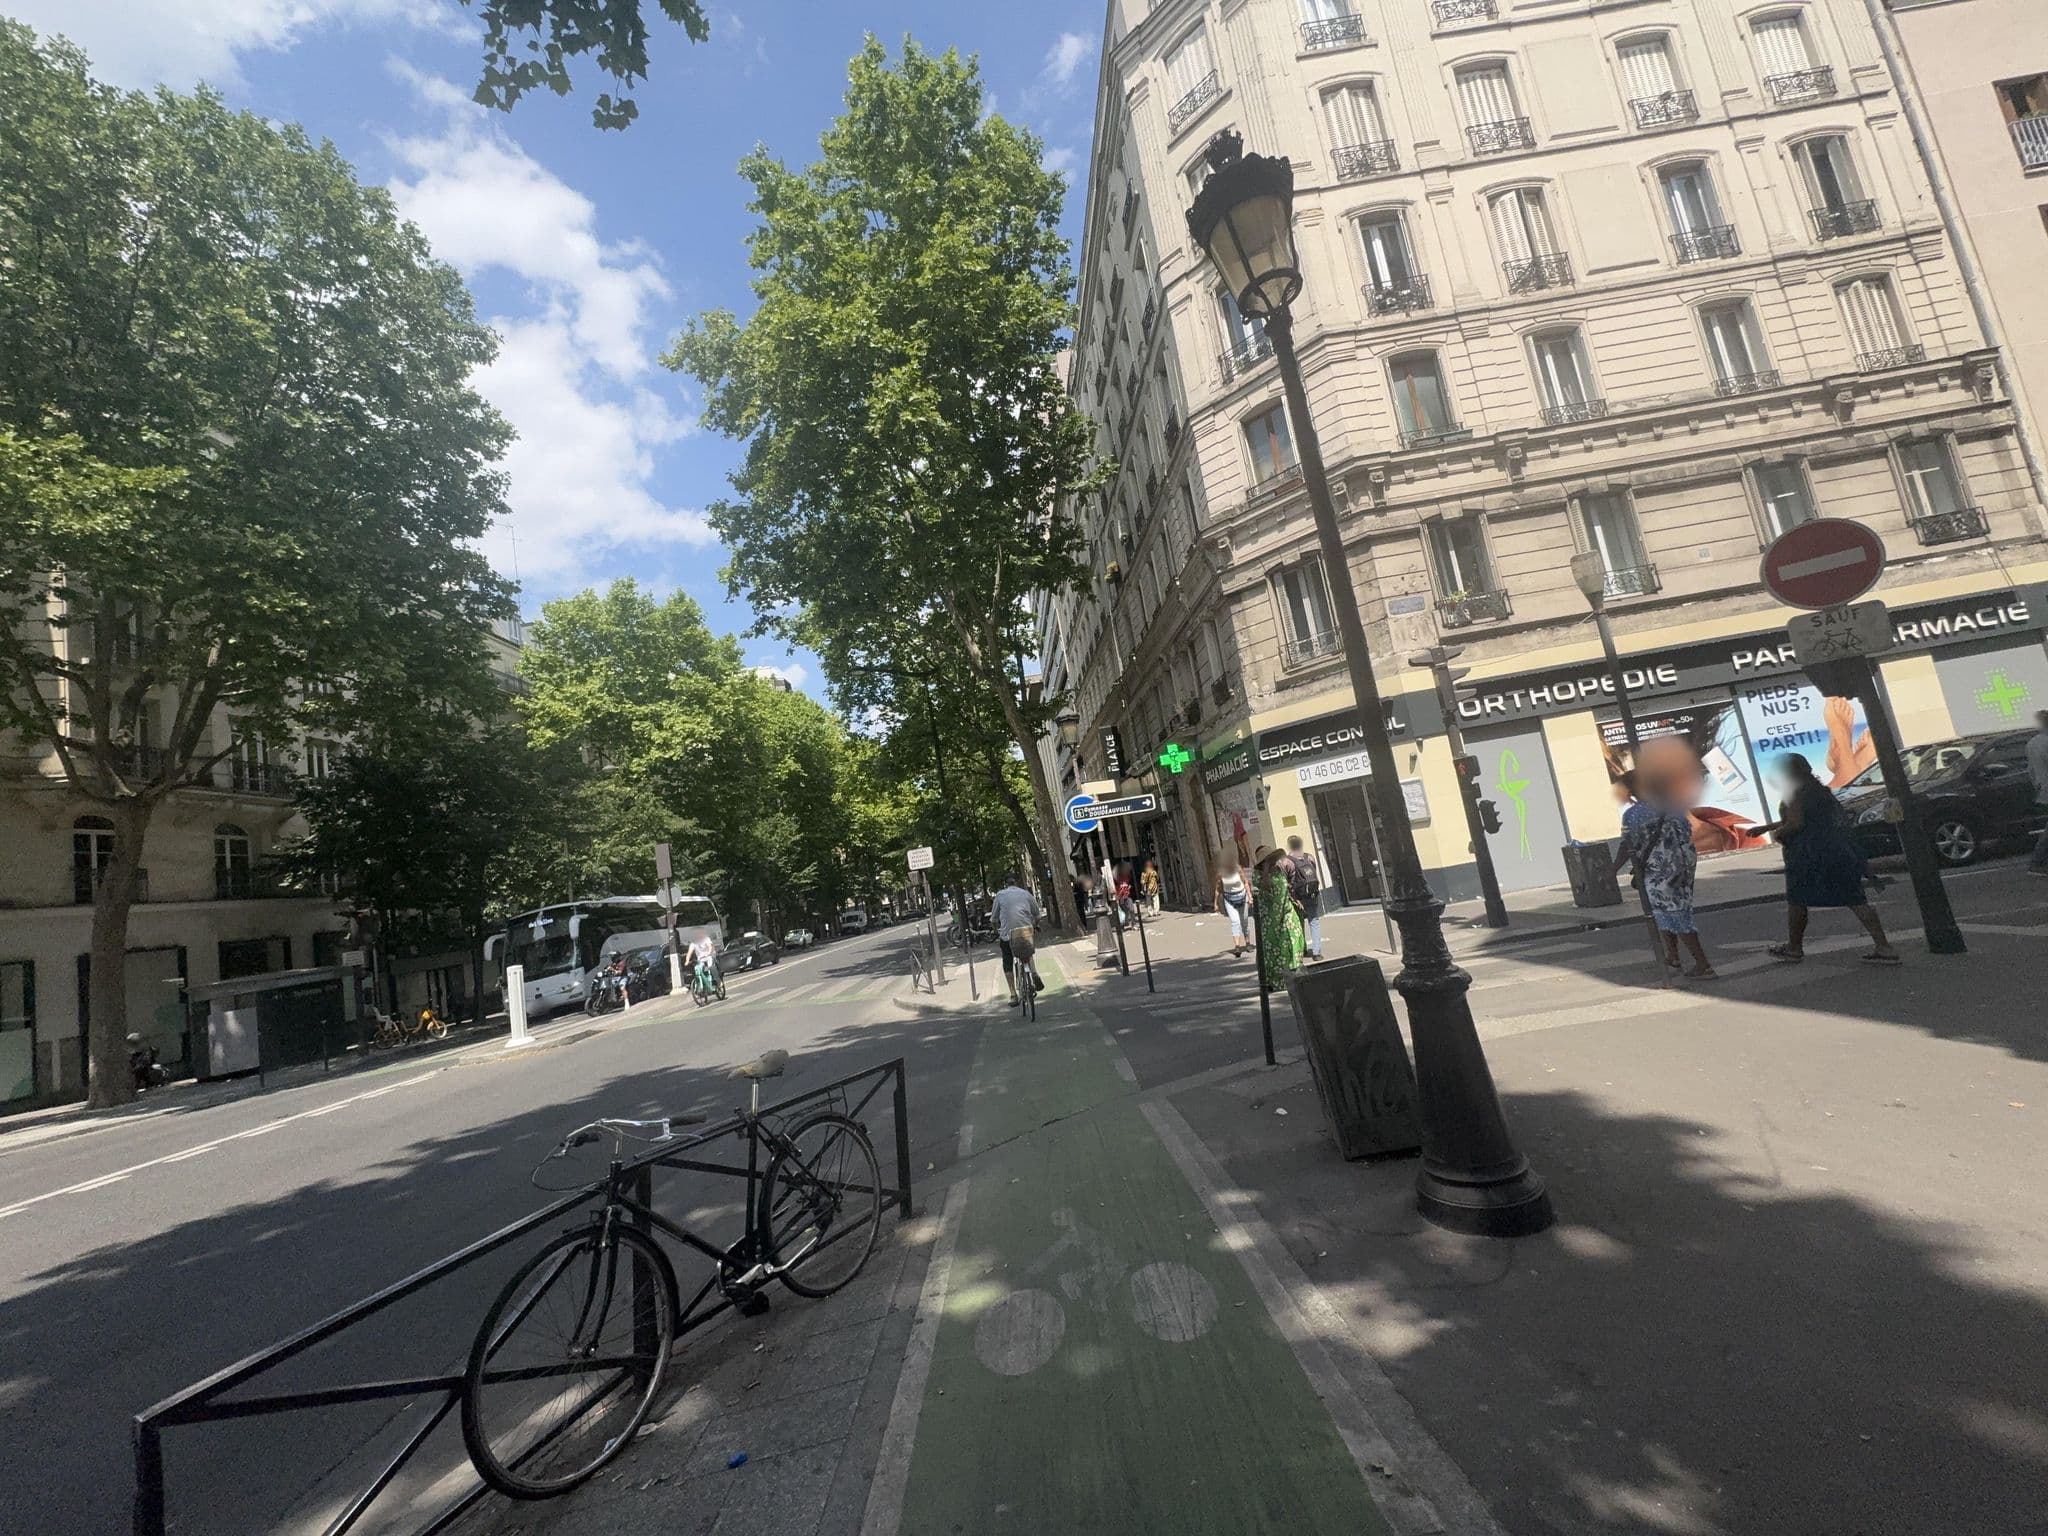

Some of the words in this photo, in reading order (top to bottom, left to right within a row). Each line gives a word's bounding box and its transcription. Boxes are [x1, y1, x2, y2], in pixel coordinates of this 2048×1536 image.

[1810, 607, 1861, 627] SAUF
[1458, 664, 1678, 719] ORTHOPEDIE
[1732, 601, 2030, 671] PARRMACIE
[1745, 682, 1800, 703] PIEDS
[1259, 735, 1323, 761] ESPACE
[1326, 716, 1406, 745] CONIL
[1766, 722, 1797, 735] C'EST
[1205, 752, 1249, 784] PHARMACIE
[1300, 768, 1313, 781] 01
[1314, 764, 1328, 778] 46
[1330, 761, 1344, 775] 06
[1346, 758, 1360, 772] 02
